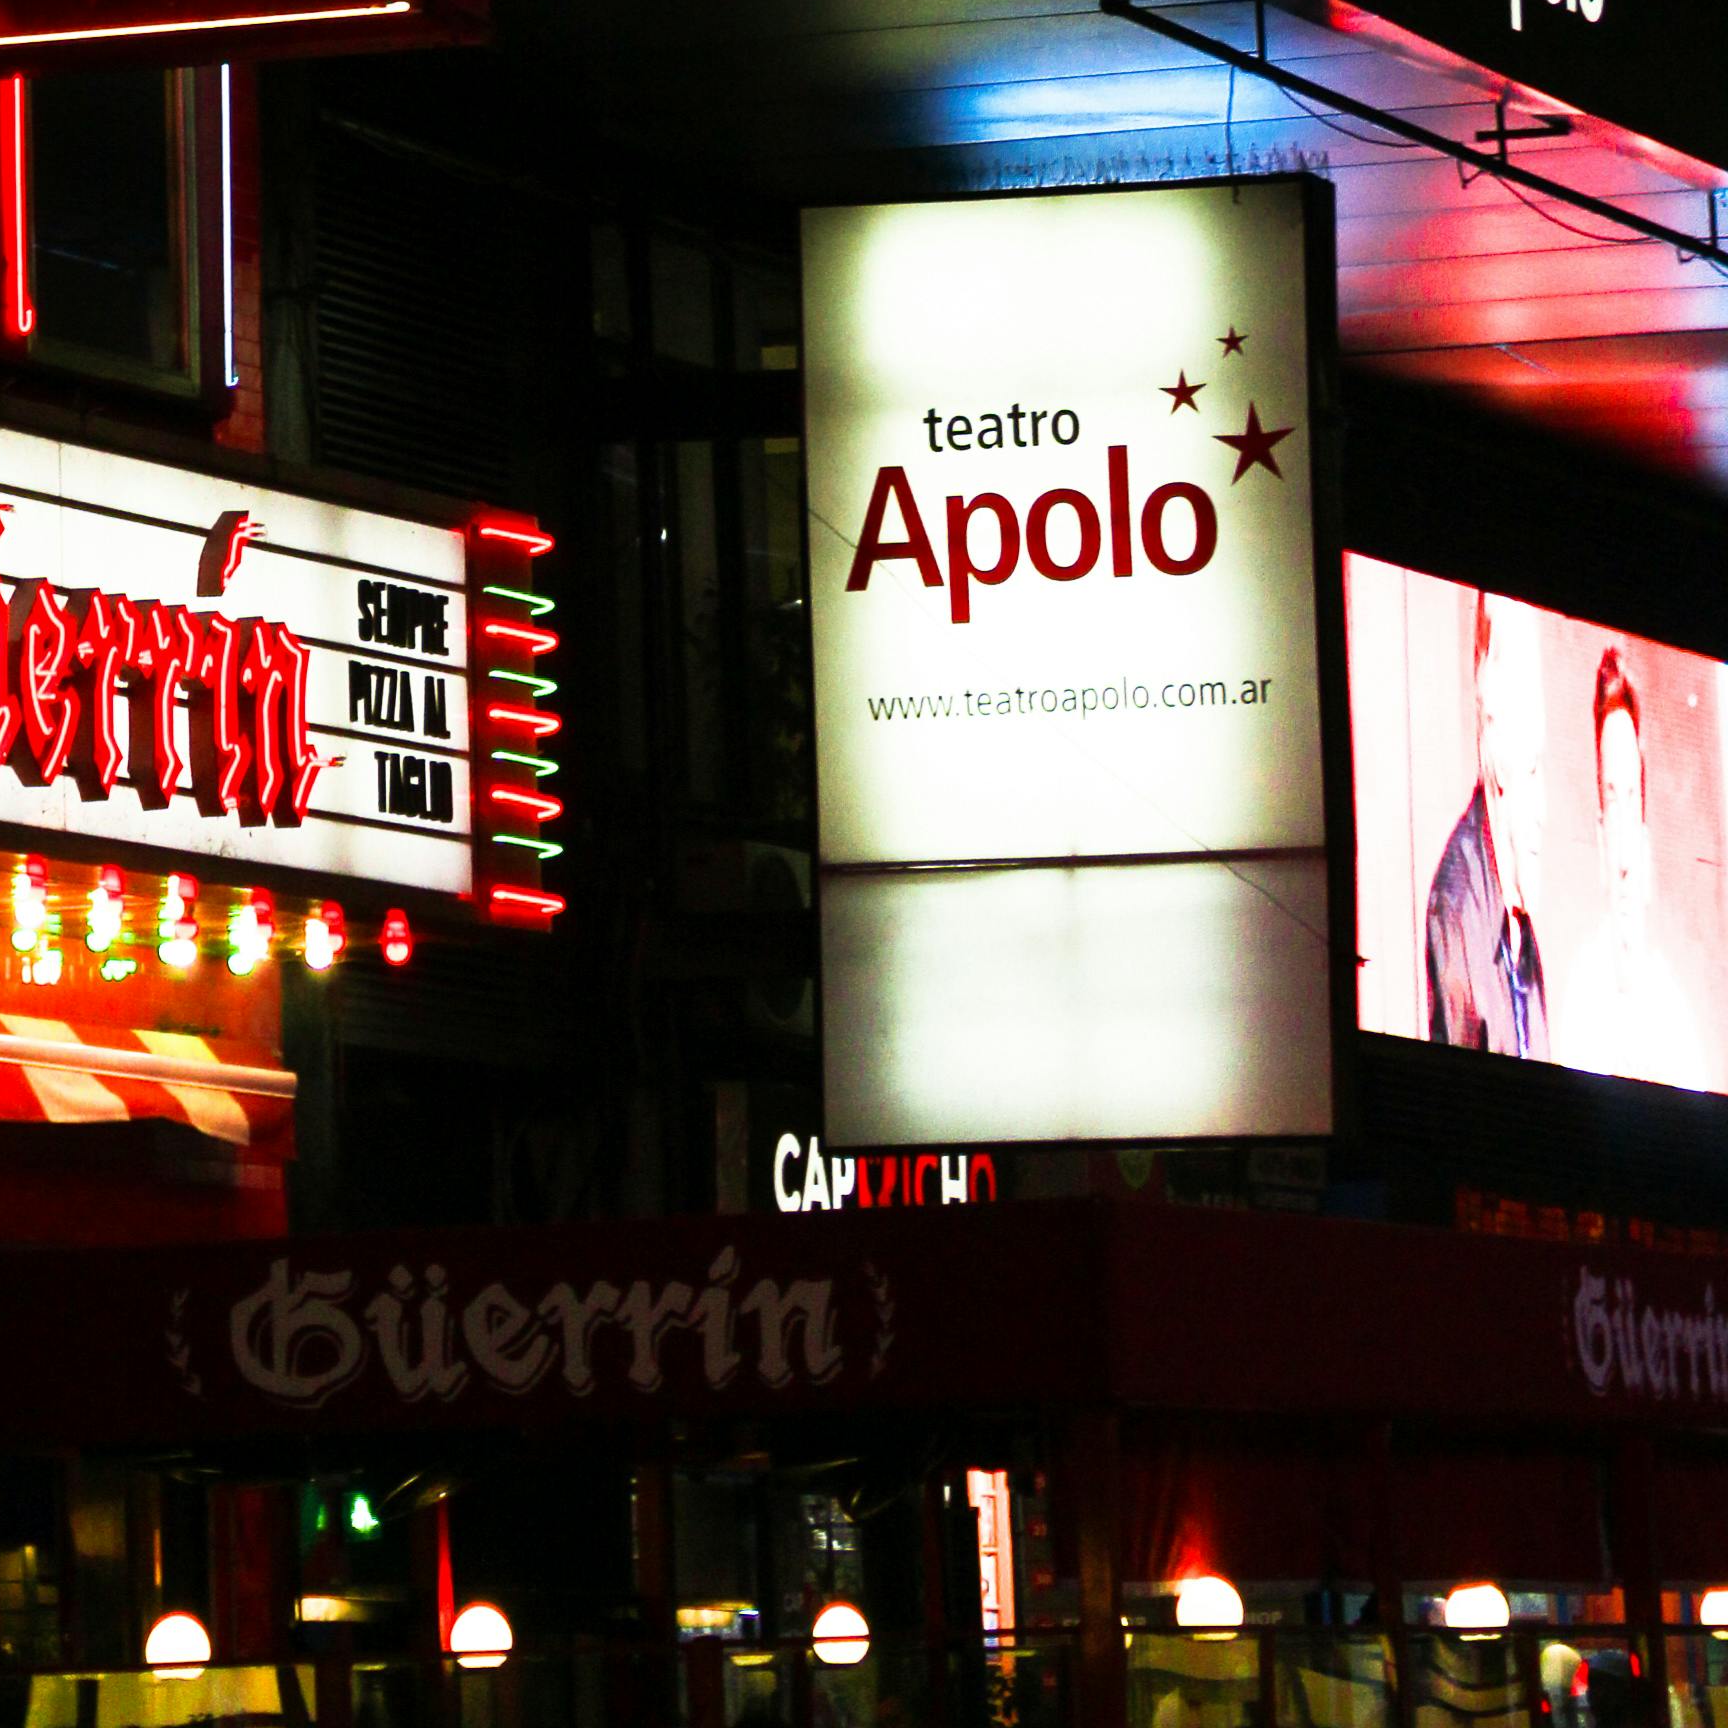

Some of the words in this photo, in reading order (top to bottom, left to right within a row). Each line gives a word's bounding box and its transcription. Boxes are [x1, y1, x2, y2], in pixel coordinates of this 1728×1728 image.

[923, 403, 1081, 453] teatro
[845, 445, 1217, 624] Apolo
[358, 579, 449, 656] SEMPRE
[348, 660, 415, 733] PIZZA
[423, 675, 451, 739] AL
[867, 676, 1273, 722] www.teatroapolo.com.ar
[373, 750, 453, 824] TAGLIO
[229, 1244, 843, 1408] Güerrin
